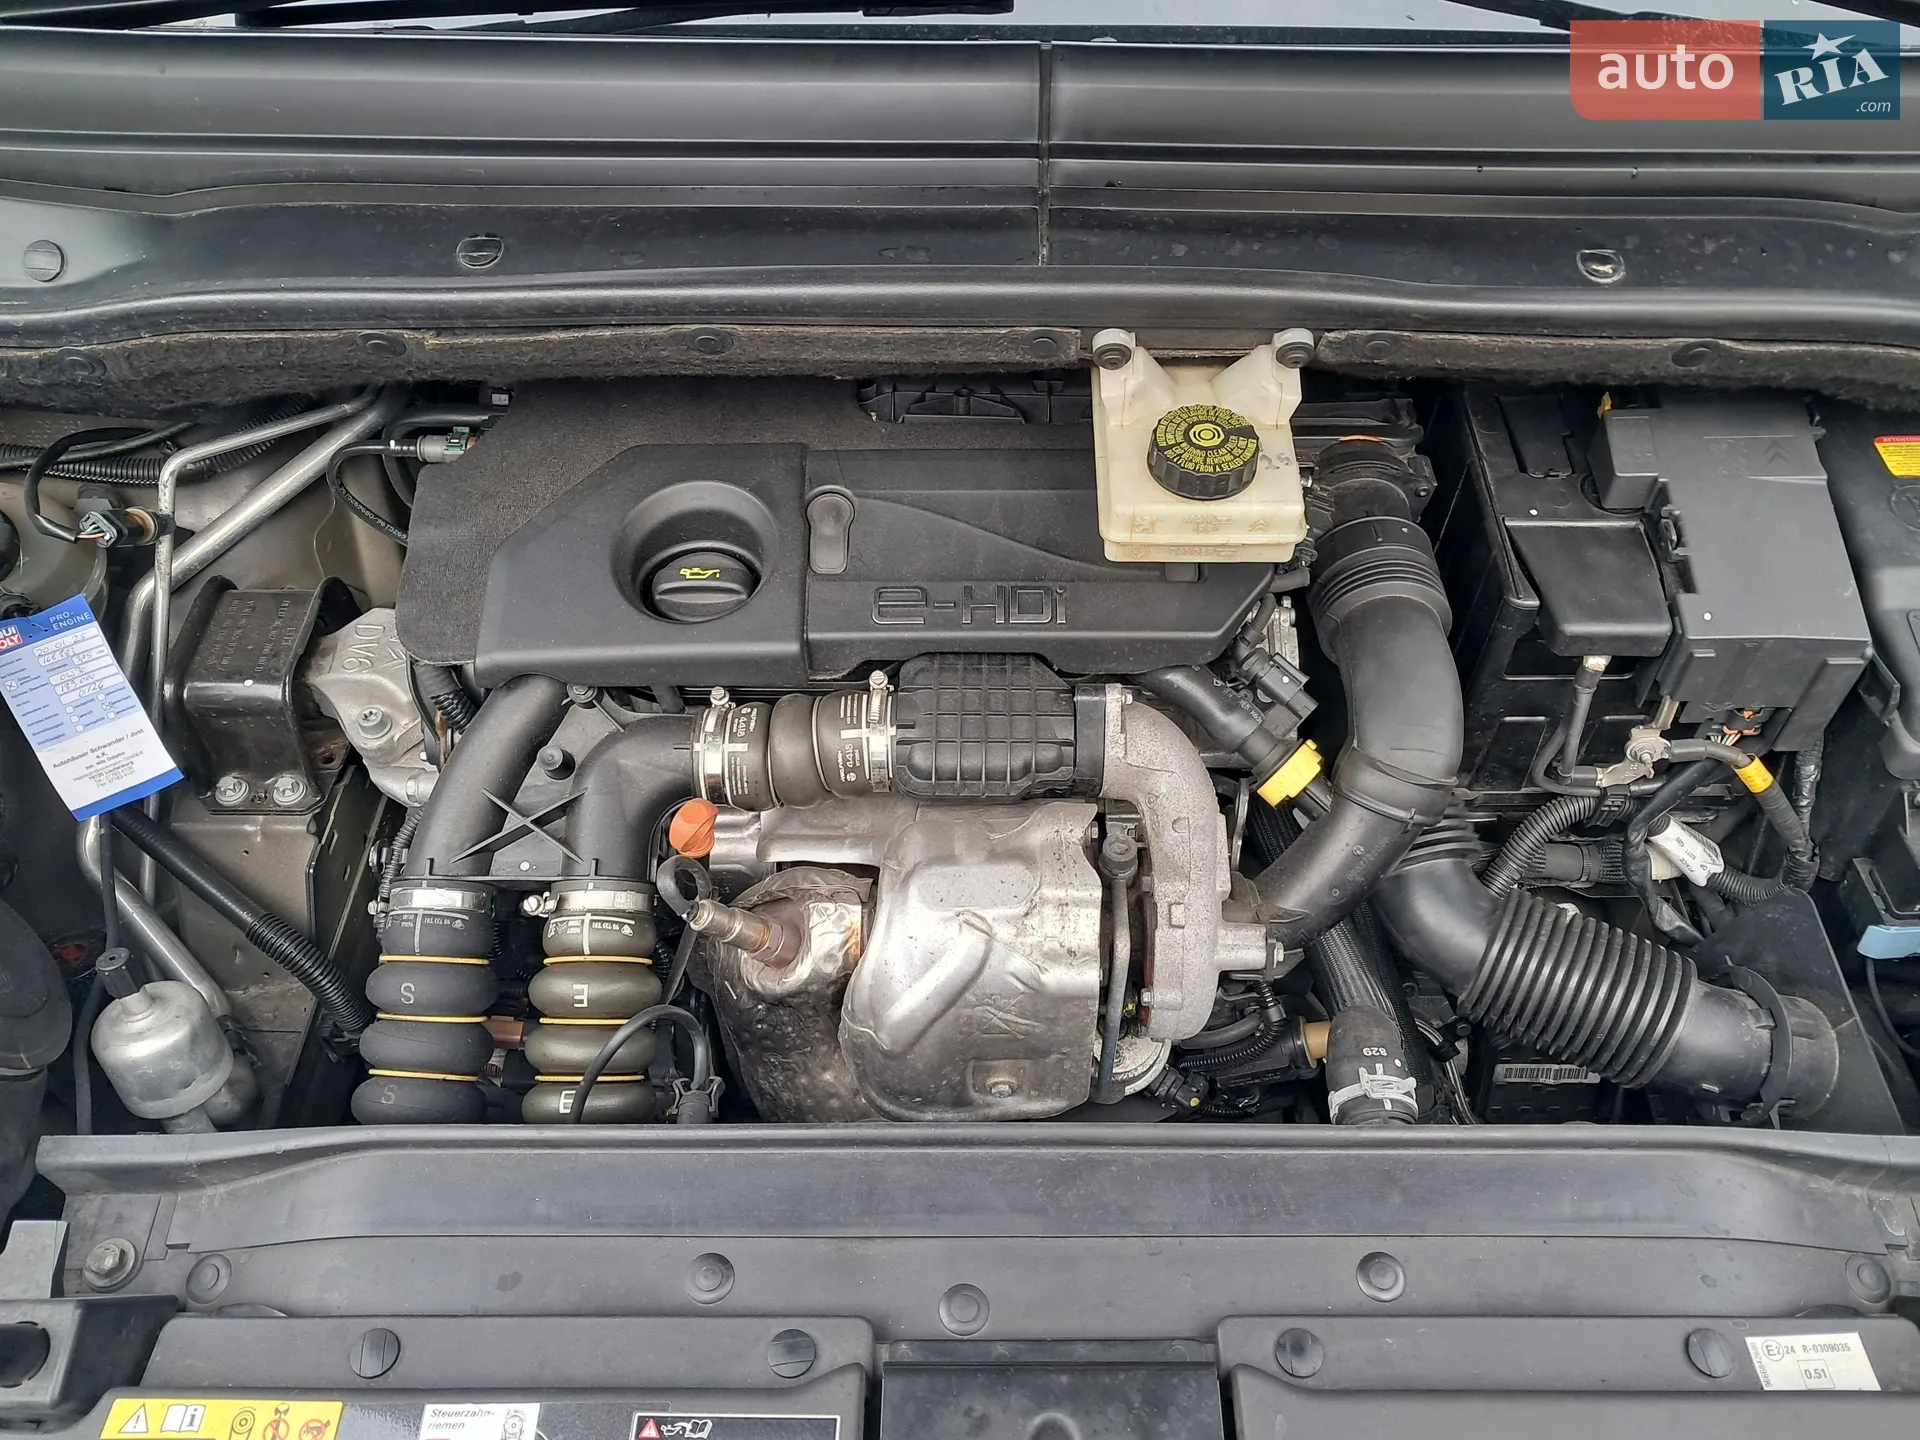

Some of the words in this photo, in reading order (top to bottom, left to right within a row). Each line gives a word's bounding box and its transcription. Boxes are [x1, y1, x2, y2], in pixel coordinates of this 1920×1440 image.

[1181, 452, 1204, 465] BEFORE
[1206, 453, 1234, 465] REMOVING
[1207, 449, 1228, 458] CLEAN
[1178, 457, 1196, 470] FLUID
[1223, 458, 1244, 471] SEALED
[872, 585, 1068, 625] e-HDi
[49, 611, 74, 623] PRO-
[52, 612, 91, 630] ENGINE
[51, 750, 89, 769] Autohäuser
[88, 735, 125, 754] Schwander
[128, 727, 144, 737] Jost
[400, 983, 415, 1005] S
[573, 984, 589, 1008] E
[1362, 1047, 1387, 1056] 829
[1784, 1346, 1796, 1354] 24
[1802, 1343, 1850, 1353] R-0309035
[1804, 1368, 1828, 1380] 0.51
[430, 1408, 494, 1418] Steuerzahn-
[427, 1420, 465, 1429] riemen
